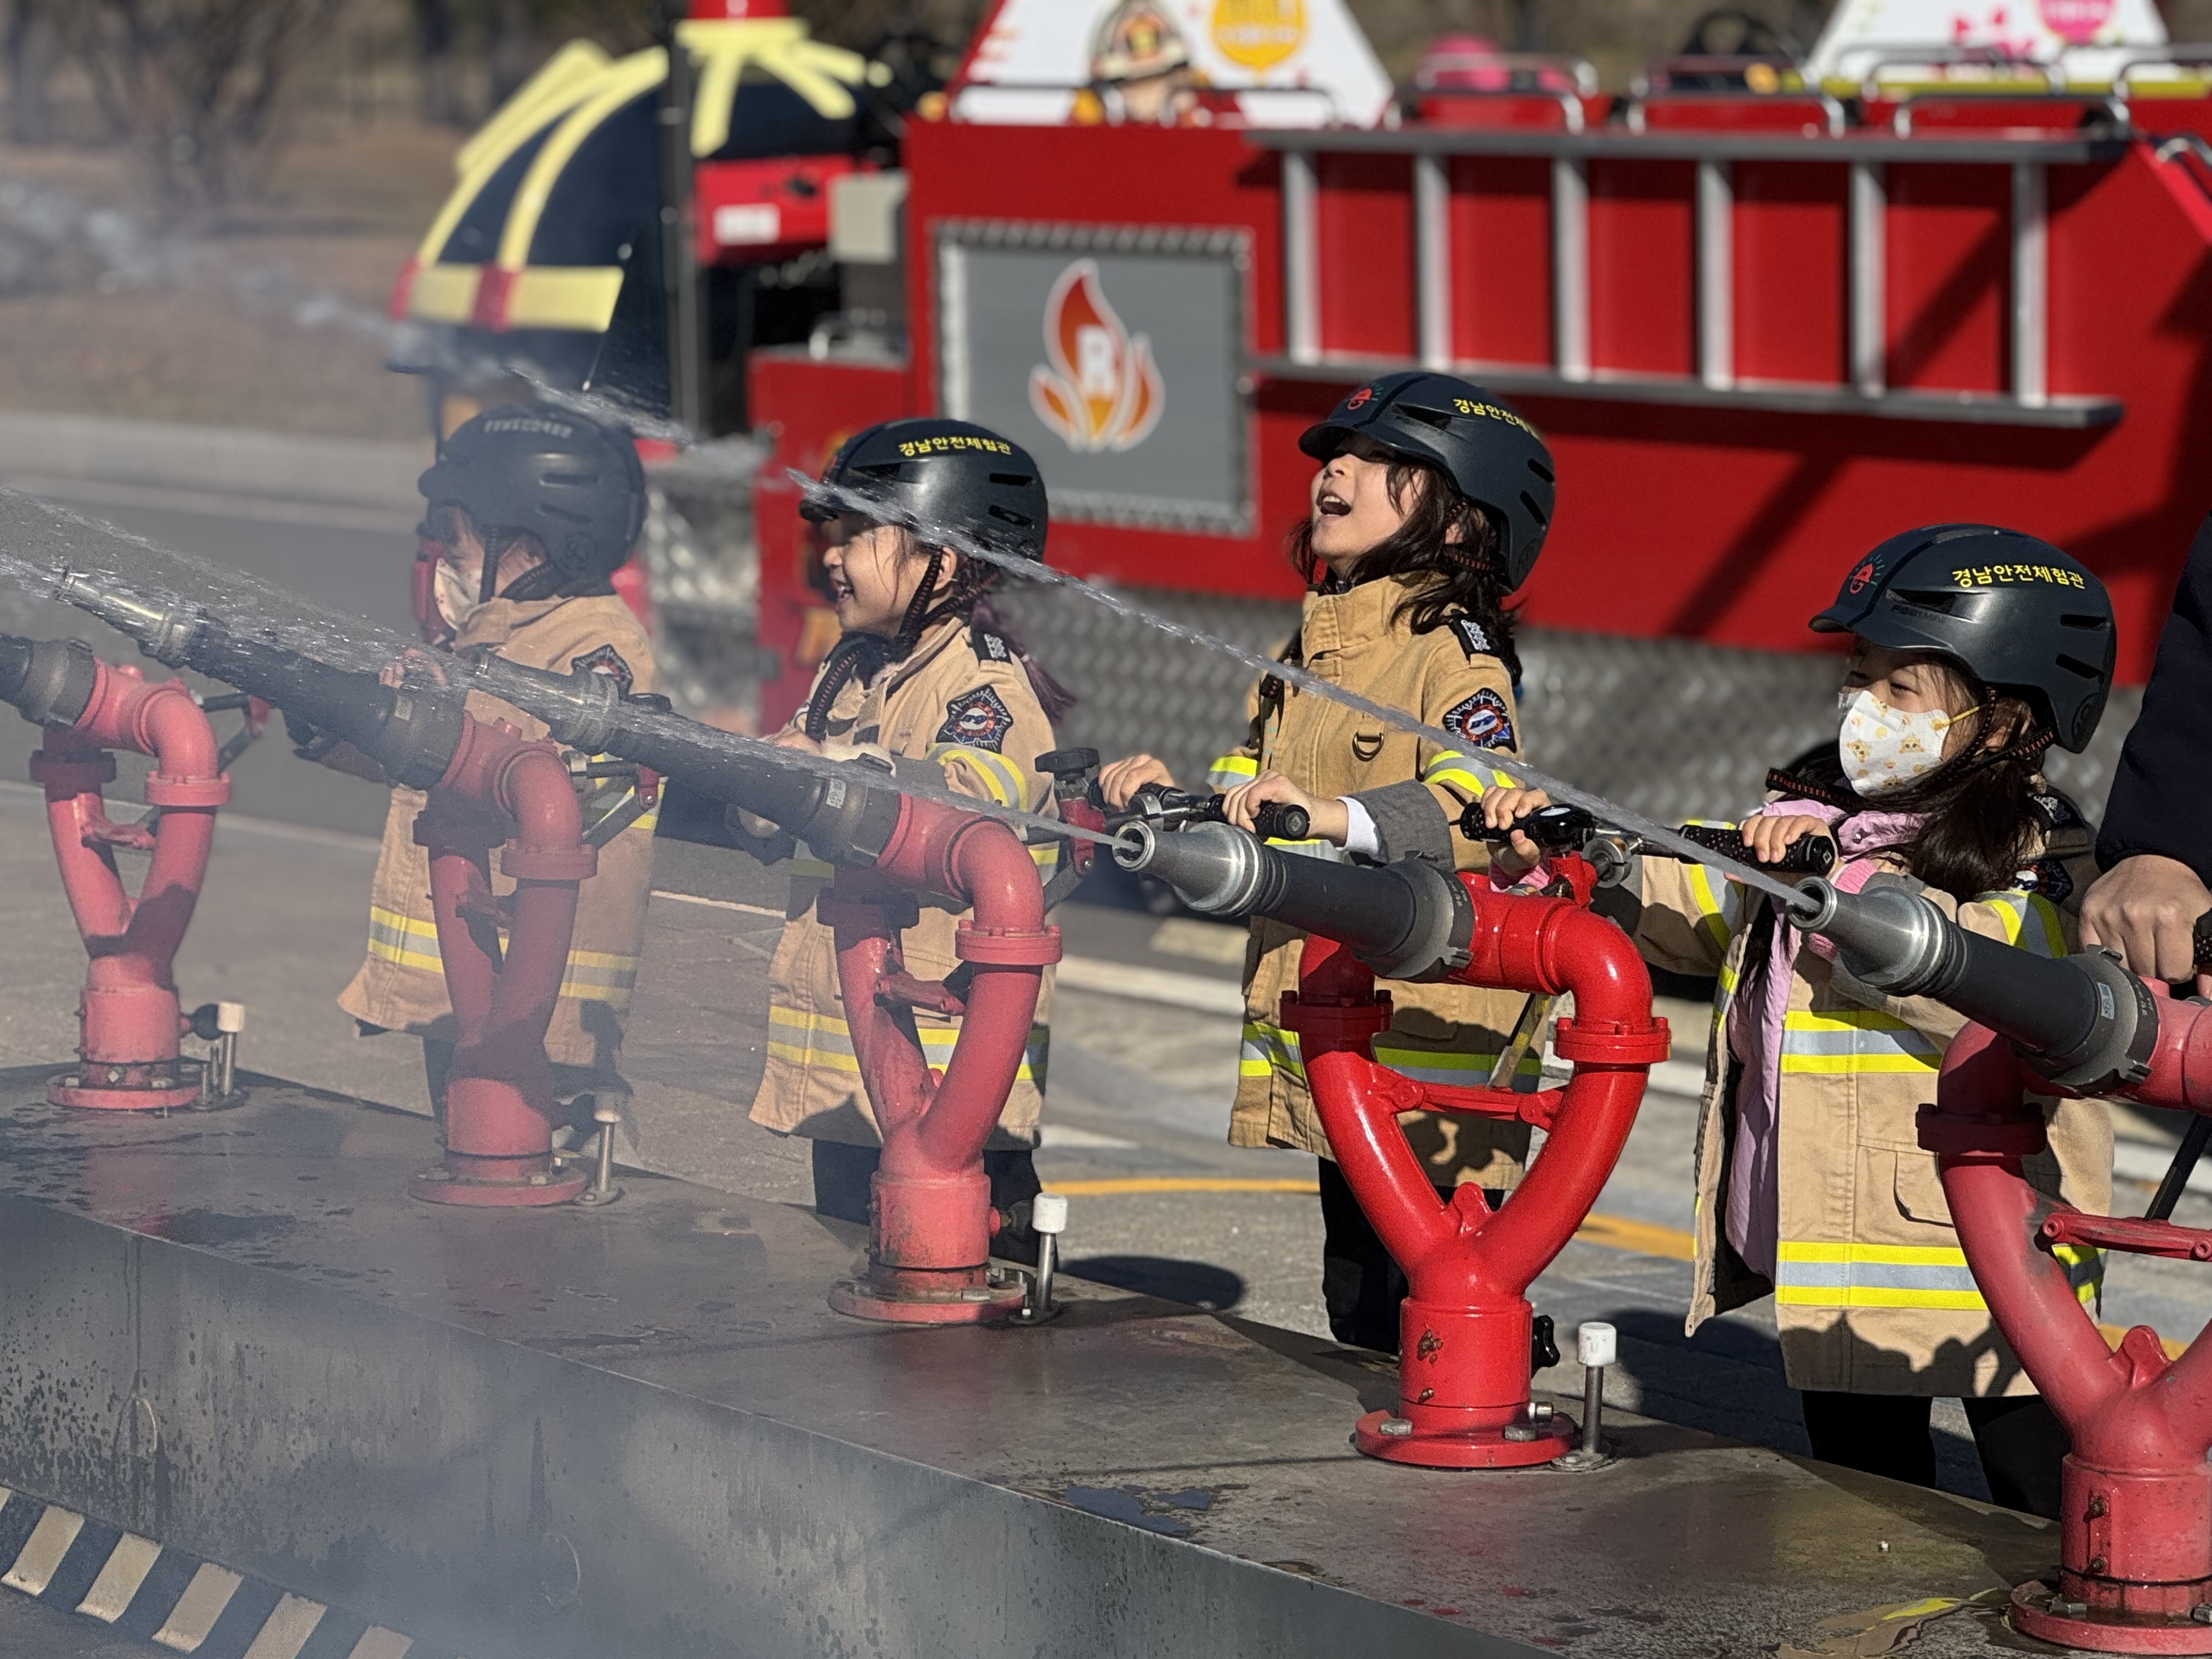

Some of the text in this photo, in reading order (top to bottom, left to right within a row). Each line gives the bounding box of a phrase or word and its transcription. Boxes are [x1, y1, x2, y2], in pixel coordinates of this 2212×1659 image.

[1453, 399, 1539, 439] 경남안전체
[899, 437, 1012, 456] 경남안전체험관
[1952, 565, 2085, 589] 경남안전체험관
